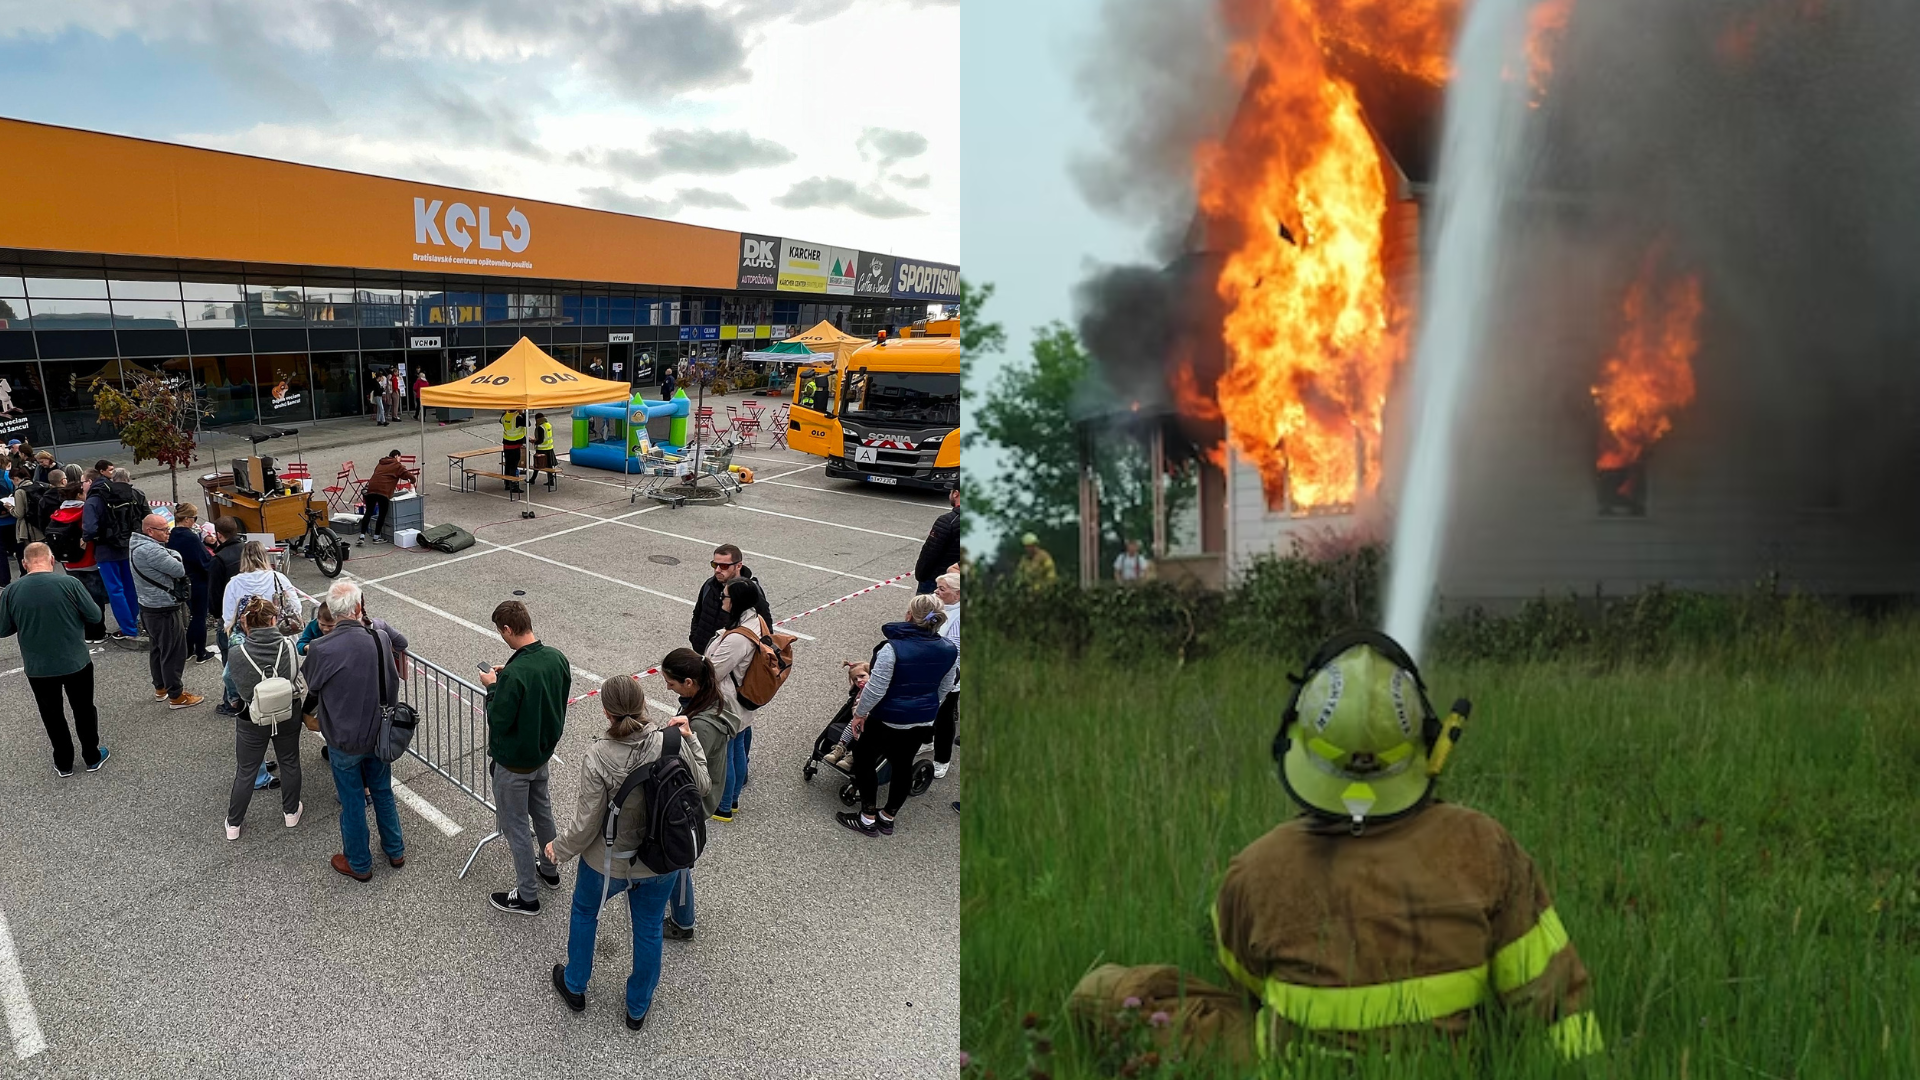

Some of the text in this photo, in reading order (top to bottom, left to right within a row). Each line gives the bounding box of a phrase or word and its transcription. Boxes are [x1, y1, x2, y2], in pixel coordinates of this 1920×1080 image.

[743, 239, 775, 261] DK
[413, 253, 452, 264] Bratislavské
[453, 257, 478, 265] centrum
[470, 374, 510, 386] OLO
[540, 372, 579, 385] OLO
[868, 432, 911, 443] SCANIA
[860, 450, 871, 461] A
